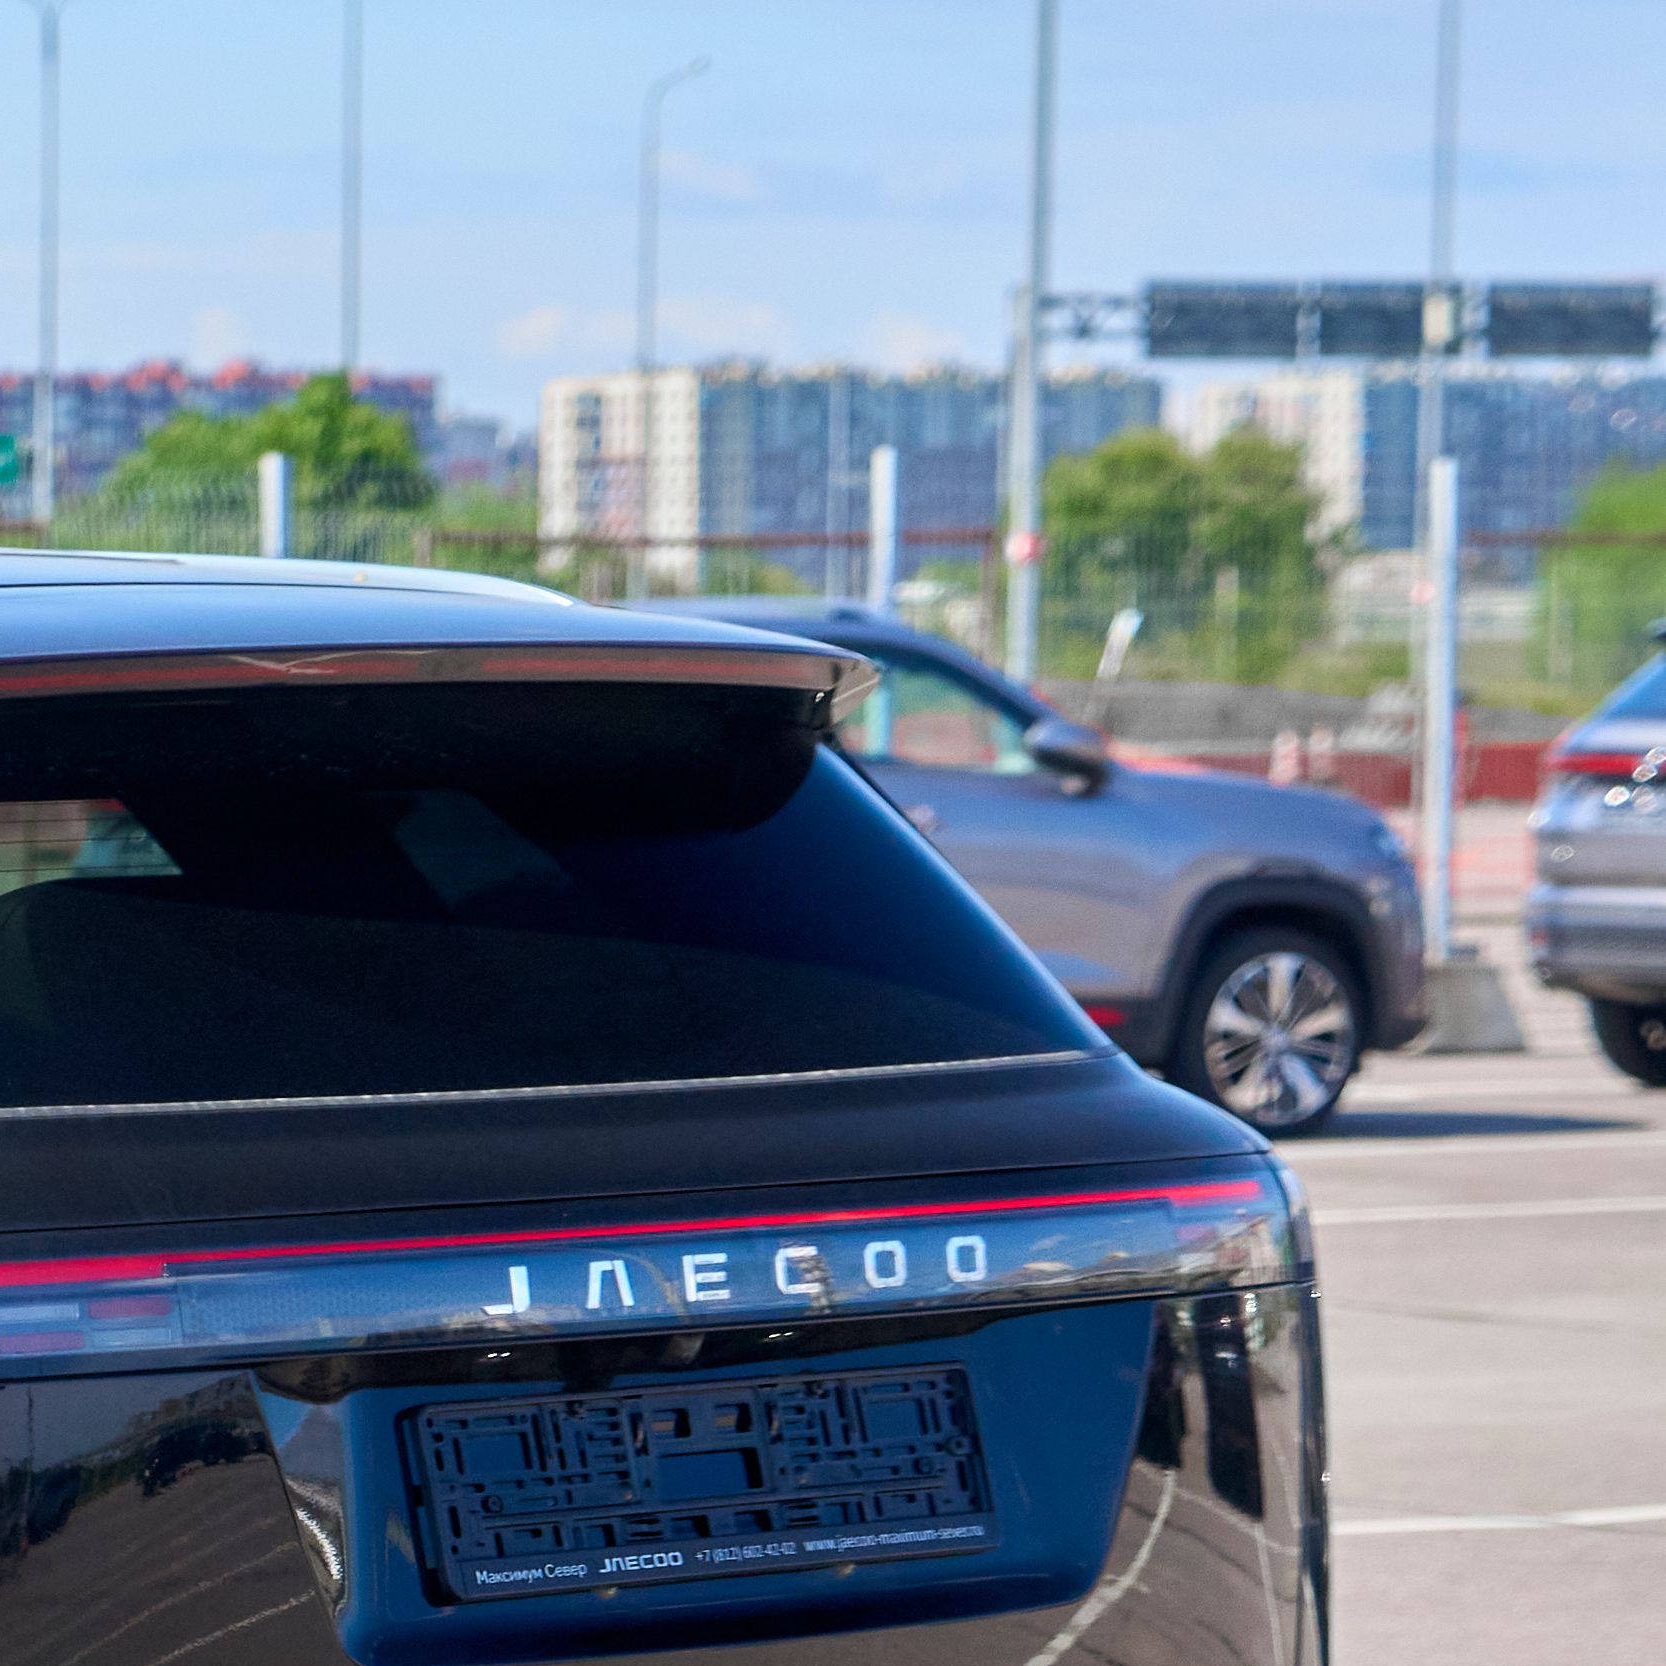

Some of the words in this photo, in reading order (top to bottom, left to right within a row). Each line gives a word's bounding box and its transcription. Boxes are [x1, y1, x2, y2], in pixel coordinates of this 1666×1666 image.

[481, 1234, 989, 1316] JAECOO
[475, 1567, 544, 1585] Максимум
[544, 1562, 588, 1577] Север
[599, 1552, 684, 1573] JAECOO
